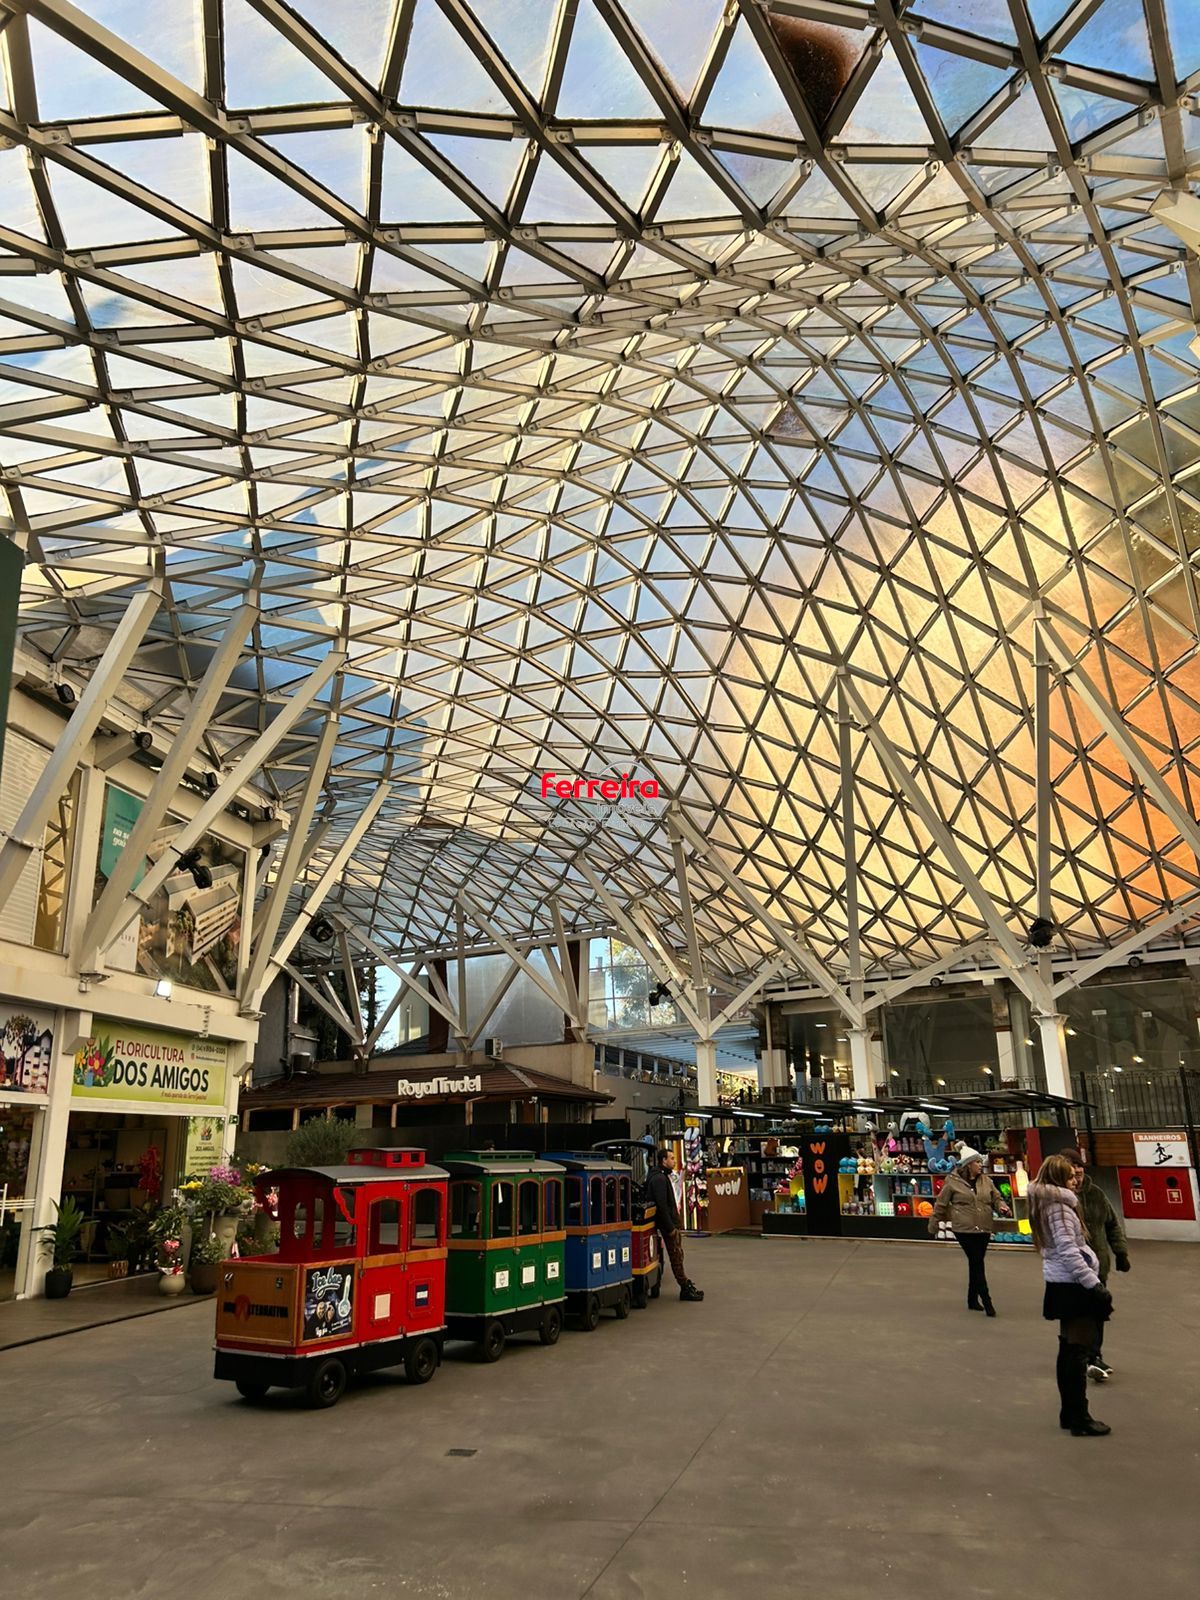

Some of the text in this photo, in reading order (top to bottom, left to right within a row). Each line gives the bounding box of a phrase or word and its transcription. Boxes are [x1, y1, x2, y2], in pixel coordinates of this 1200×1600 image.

[115, 1040, 185, 1063] FLORICULTURA
[113, 1059, 209, 1092] DOS AMIGOS
[1133, 1191, 1143, 1201] H
